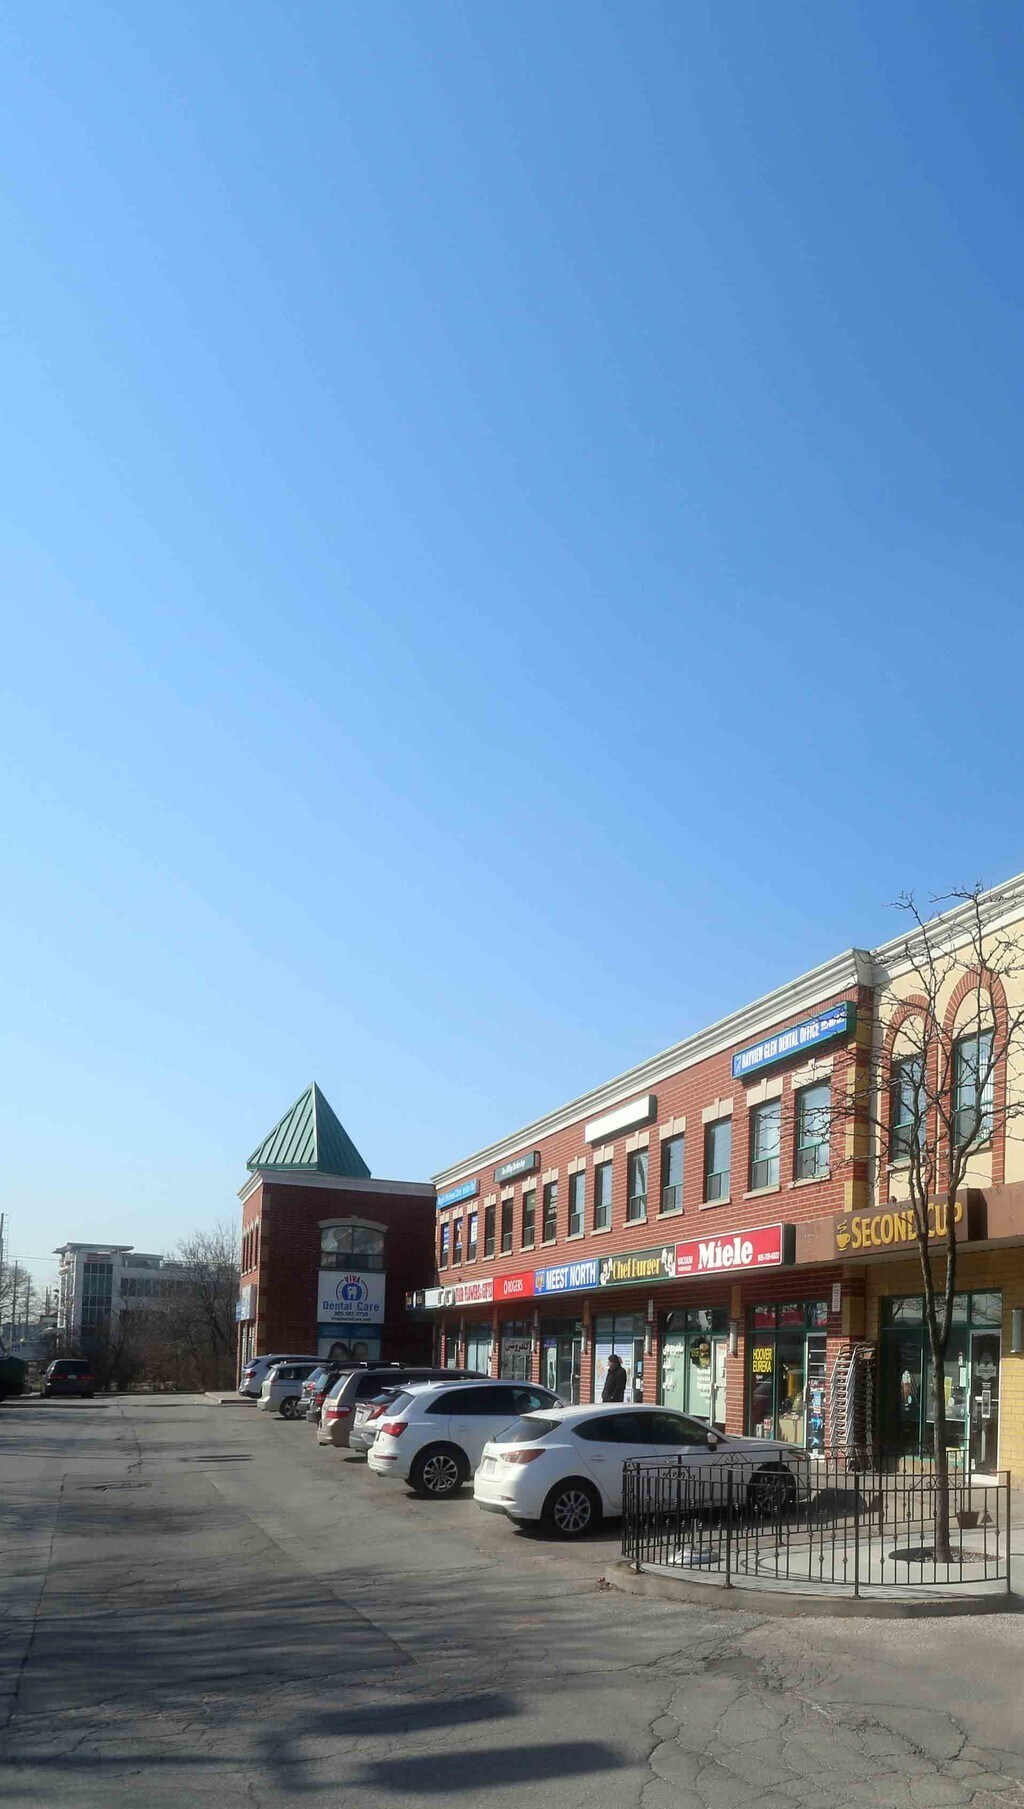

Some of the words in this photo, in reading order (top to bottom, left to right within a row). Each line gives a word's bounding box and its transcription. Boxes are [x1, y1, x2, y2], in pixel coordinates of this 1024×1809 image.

[764, 1039, 778, 1059] GLEN
[778, 1029, 799, 1053] DENTAL
[799, 1023, 820, 1044] OFFICE
[698, 1237, 754, 1270] Miele
[545, 1266, 569, 1290] MEEST
[569, 1261, 596, 1287] NORTH
[612, 1258, 631, 1280] Chef
[631, 1257, 661, 1277] Burger
[344, 1275, 361, 1284] VIVA
[507, 1279, 524, 1294] ROGERS
[322, 1301, 353, 1311] Dental
[357, 1302, 380, 1312] Care
[752, 1348, 773, 1360] HOOVER
[752, 1360, 772, 1373] EUREKA
